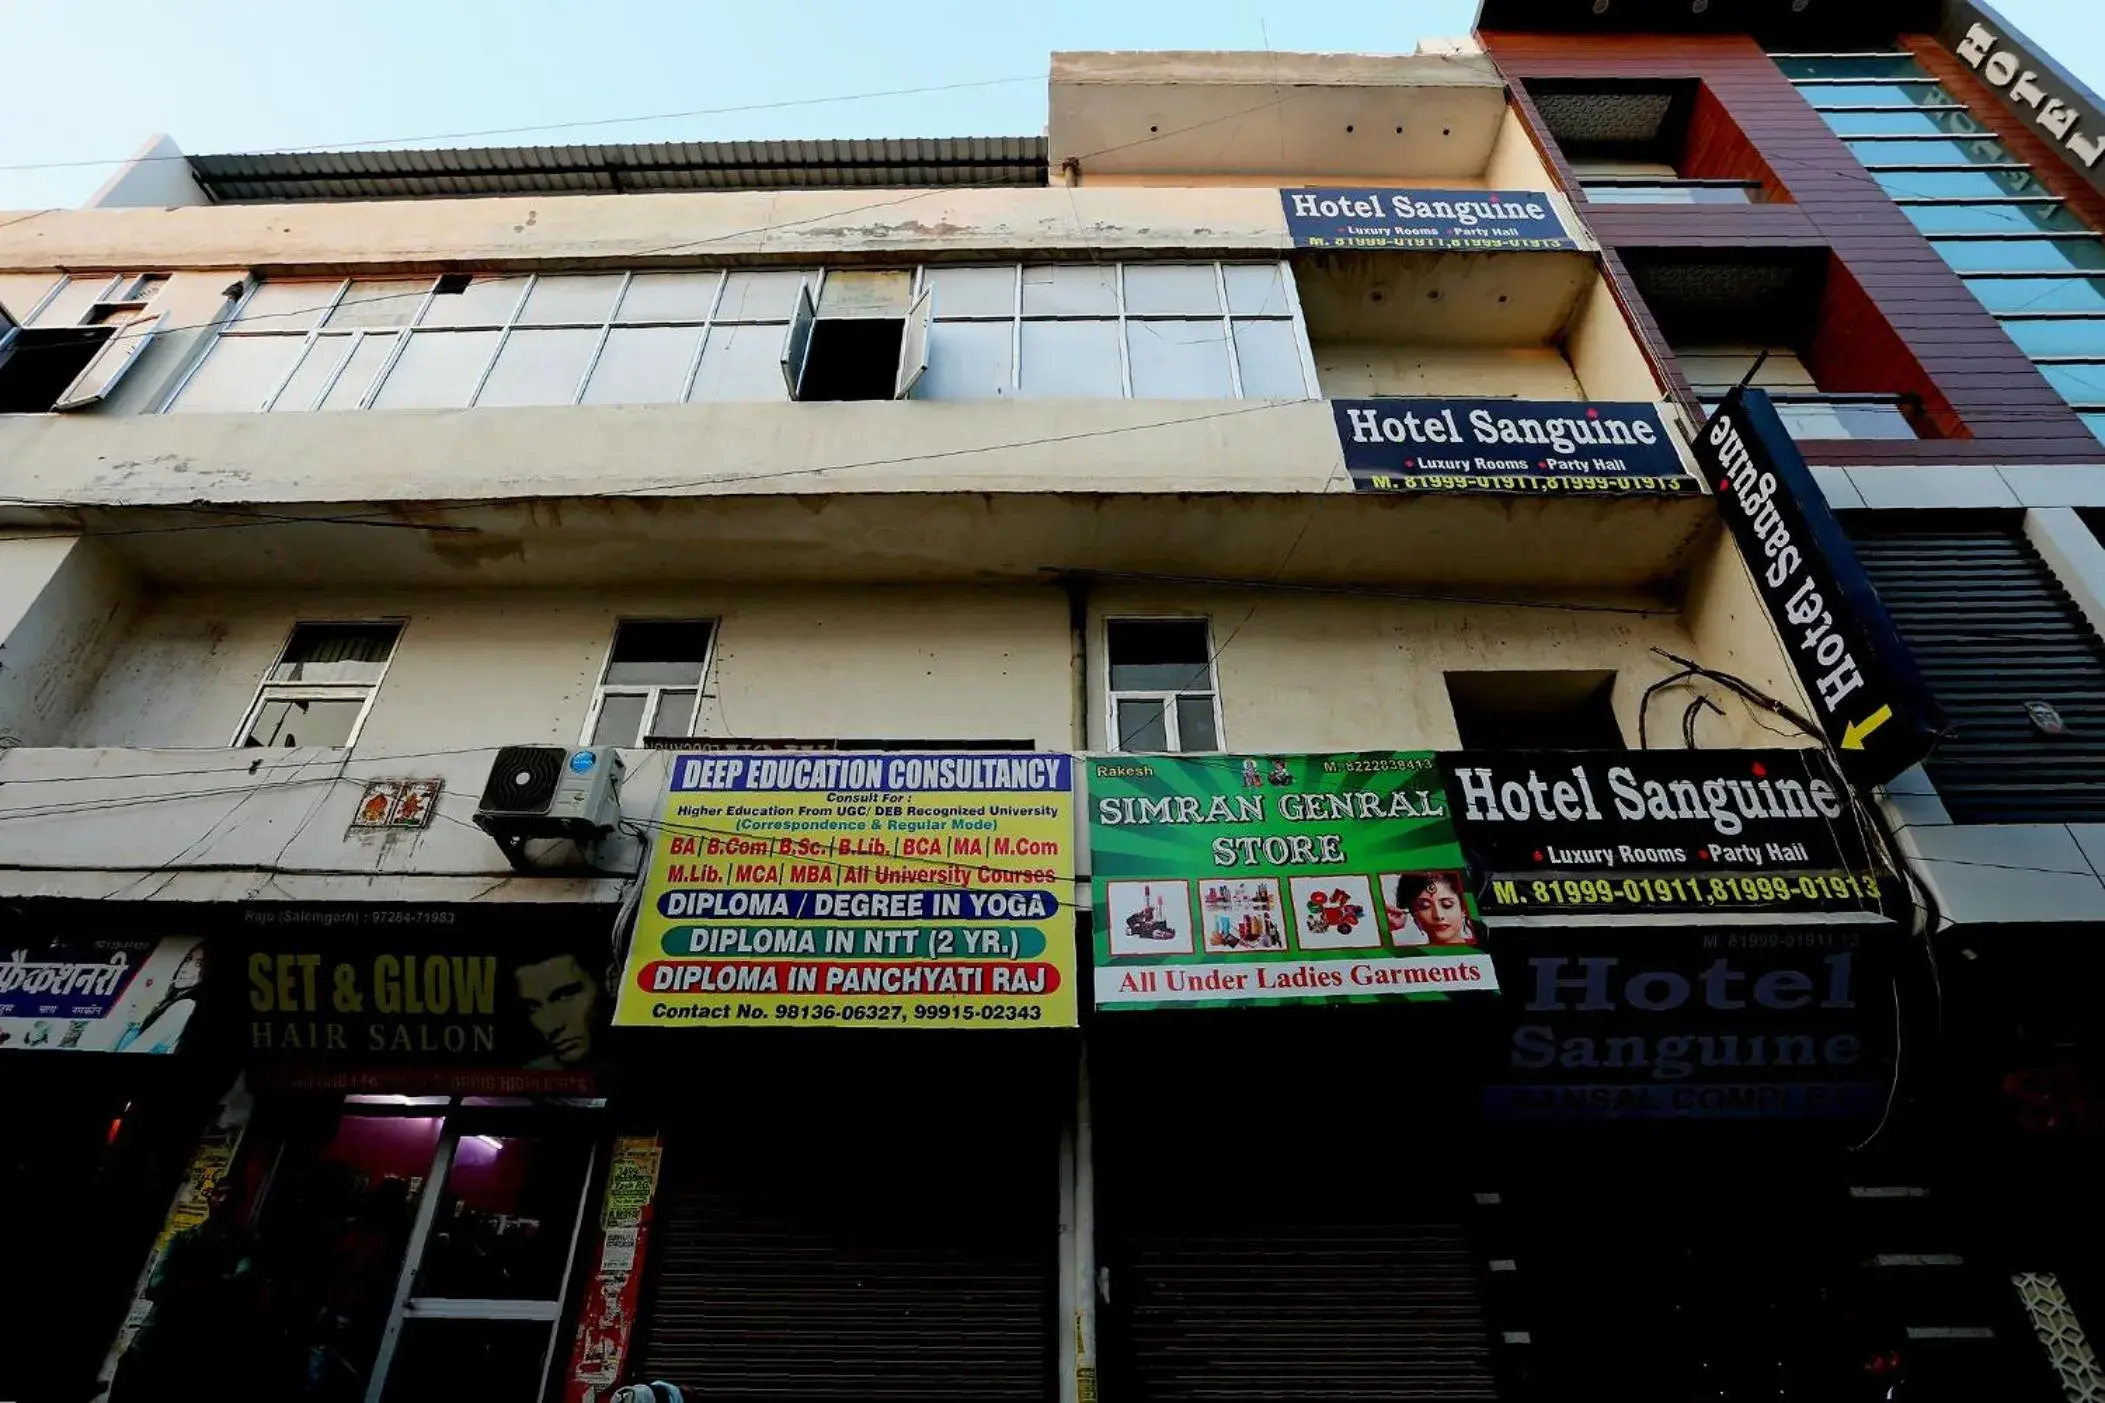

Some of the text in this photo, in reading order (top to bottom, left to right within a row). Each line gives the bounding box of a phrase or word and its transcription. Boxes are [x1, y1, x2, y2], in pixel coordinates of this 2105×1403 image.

[1956, 22, 2105, 167] HOTEL
[1291, 193, 1546, 225] Hotel Sanguine
[1348, 226, 1519, 238] Luxury Rooms Party Hall
[1346, 408, 1657, 454] Hotel Sanguine
[1416, 456, 1626, 473] Luxury Rooms Party Hall
[1709, 414, 1865, 712] Hotel Sanguine
[682, 758, 1061, 790] DEEP EDUCATION CONSULTANCY
[1097, 765, 1154, 778] Rakesh
[677, 806, 723, 818] Higher
[726, 806, 794, 817] Education
[798, 807, 833, 817] From
[875, 806, 903, 817] DEB
[907, 806, 986, 818] Recognized
[990, 806, 1058, 818] University
[826, 792, 878, 803] Consult
[882, 792, 904, 803] For
[1099, 789, 1445, 826] SIMRAN GENRAL
[1454, 763, 1842, 836] Hotel Sanguine
[736, 818, 997, 832] (Correspondence & Regular Mode)
[670, 836, 1058, 857] BA B.Com B.Sc. B.Lib. BCA MA M.Com
[1210, 833, 1348, 868] STORE
[1546, 842, 1809, 867] Luxury Rooms Party Hall
[667, 863, 1057, 887] M.Lib. MCA MBA All University Courses
[667, 892, 789, 917] DIPLOMA
[814, 892, 923, 918] DEGREE
[932, 893, 961, 917] IN
[969, 893, 1046, 918] YOGA
[1492, 880, 1527, 904] M.
[689, 928, 1019, 959] DIPLOMA IN NTT (2 YR.)
[248, 952, 498, 1015] SET & GLOW
[653, 965, 1046, 993] DIPLOMA IN PANCHYATI RAJ
[1119, 960, 1482, 994] All Under Ladies Garments
[1523, 951, 1858, 1012] Hotel
[652, 1002, 1042, 1023] Contact No. 98136-06327, 99915-02343
[251, 1020, 497, 1053] HAIR SALON
[1509, 1023, 1863, 1081] Sanguine
